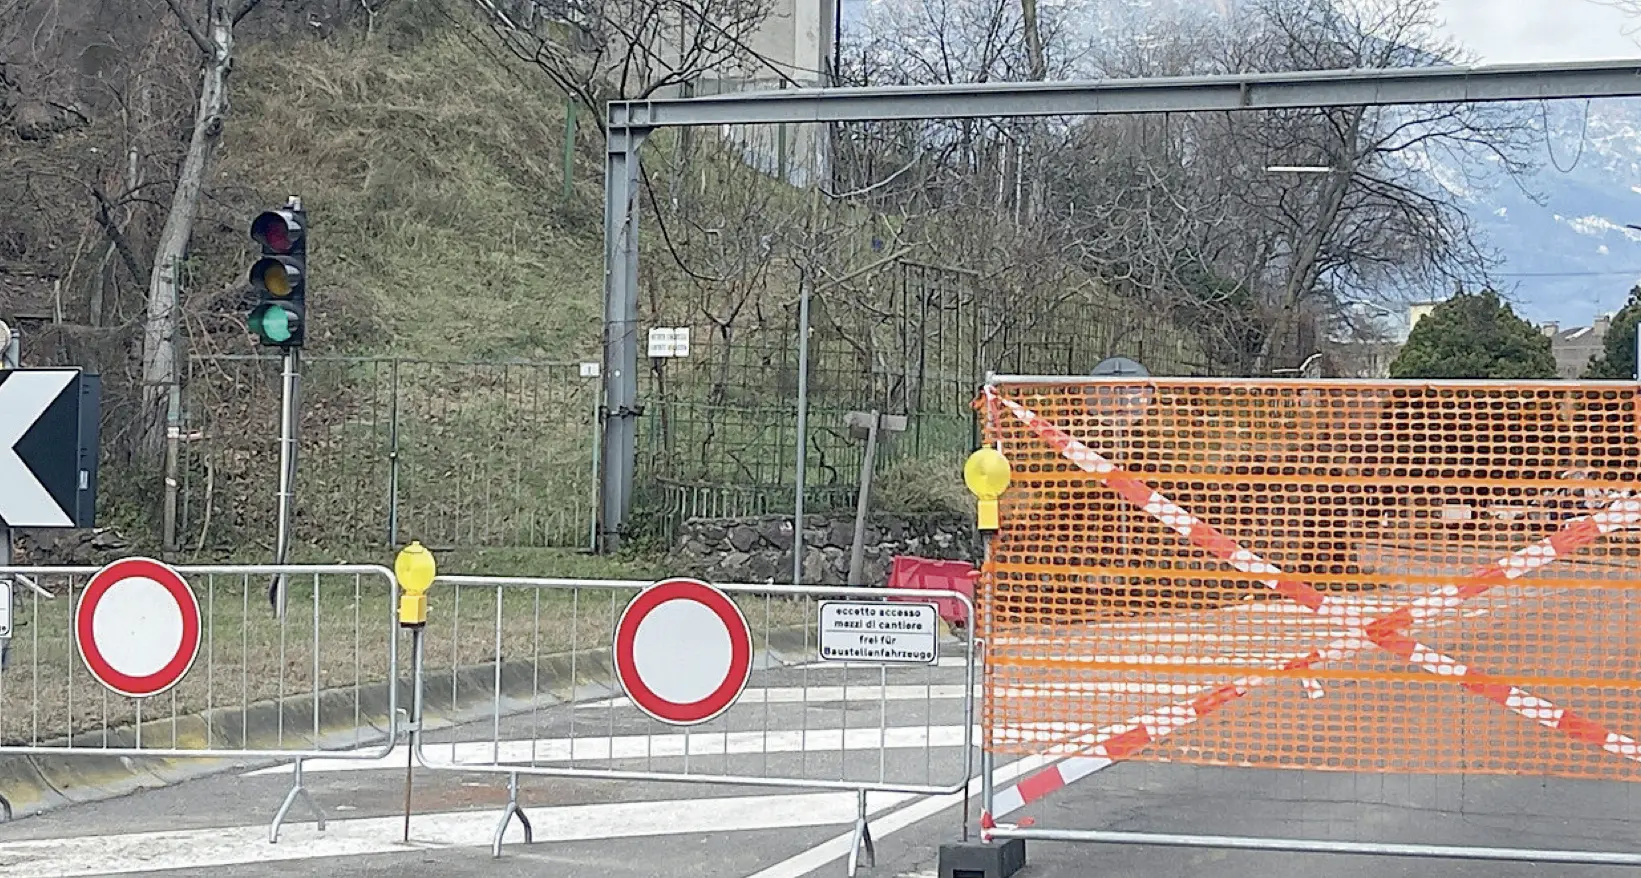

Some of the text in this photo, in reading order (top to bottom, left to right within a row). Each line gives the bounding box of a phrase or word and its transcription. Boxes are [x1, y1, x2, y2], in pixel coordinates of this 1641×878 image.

[836, 608, 921, 617] eccetto accesso
[834, 620, 922, 630] mezzi di cantiere
[859, 635, 897, 645] frei für
[824, 647, 932, 659] Baustellenfahrzeuge
